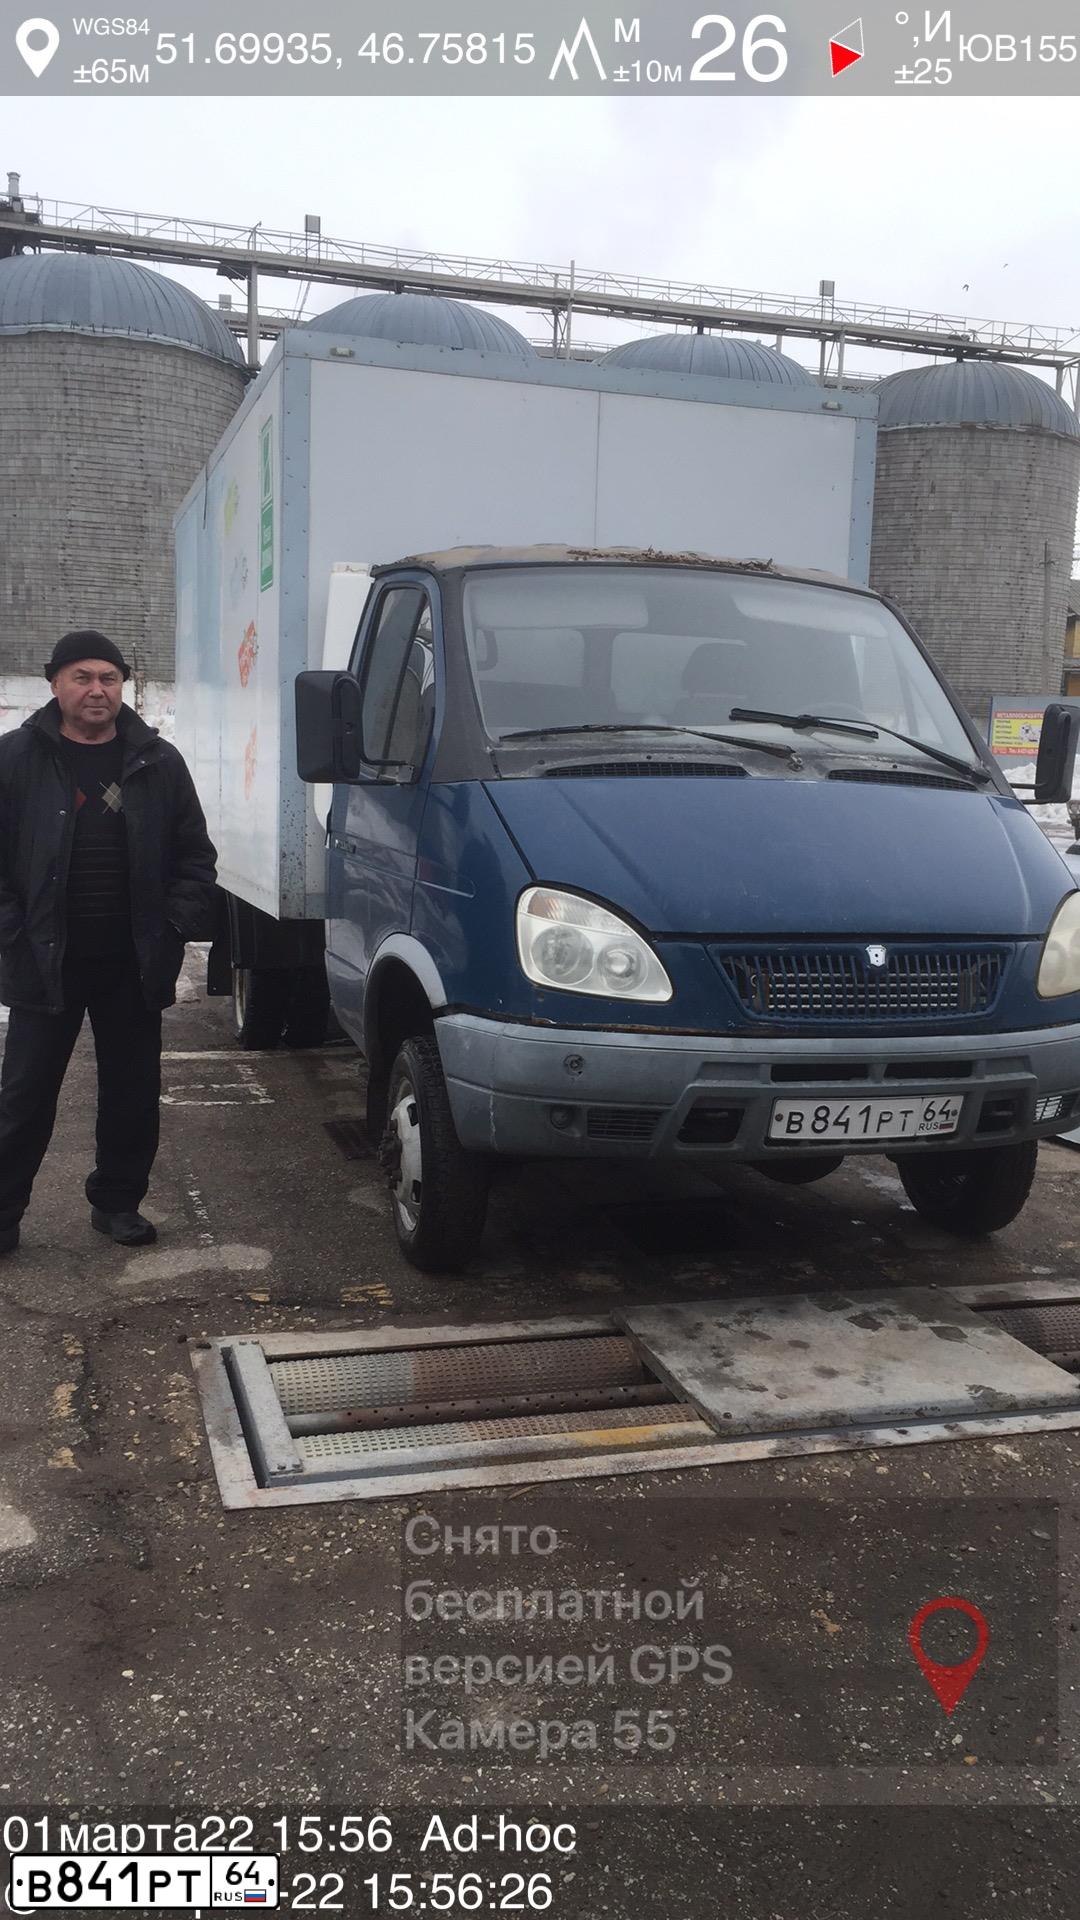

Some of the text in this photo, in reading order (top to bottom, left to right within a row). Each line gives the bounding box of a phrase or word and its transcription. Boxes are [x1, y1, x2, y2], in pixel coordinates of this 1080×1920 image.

[785, 1098, 952, 1135] В841РТ 64
[918, 1122, 939, 1132] RUS
